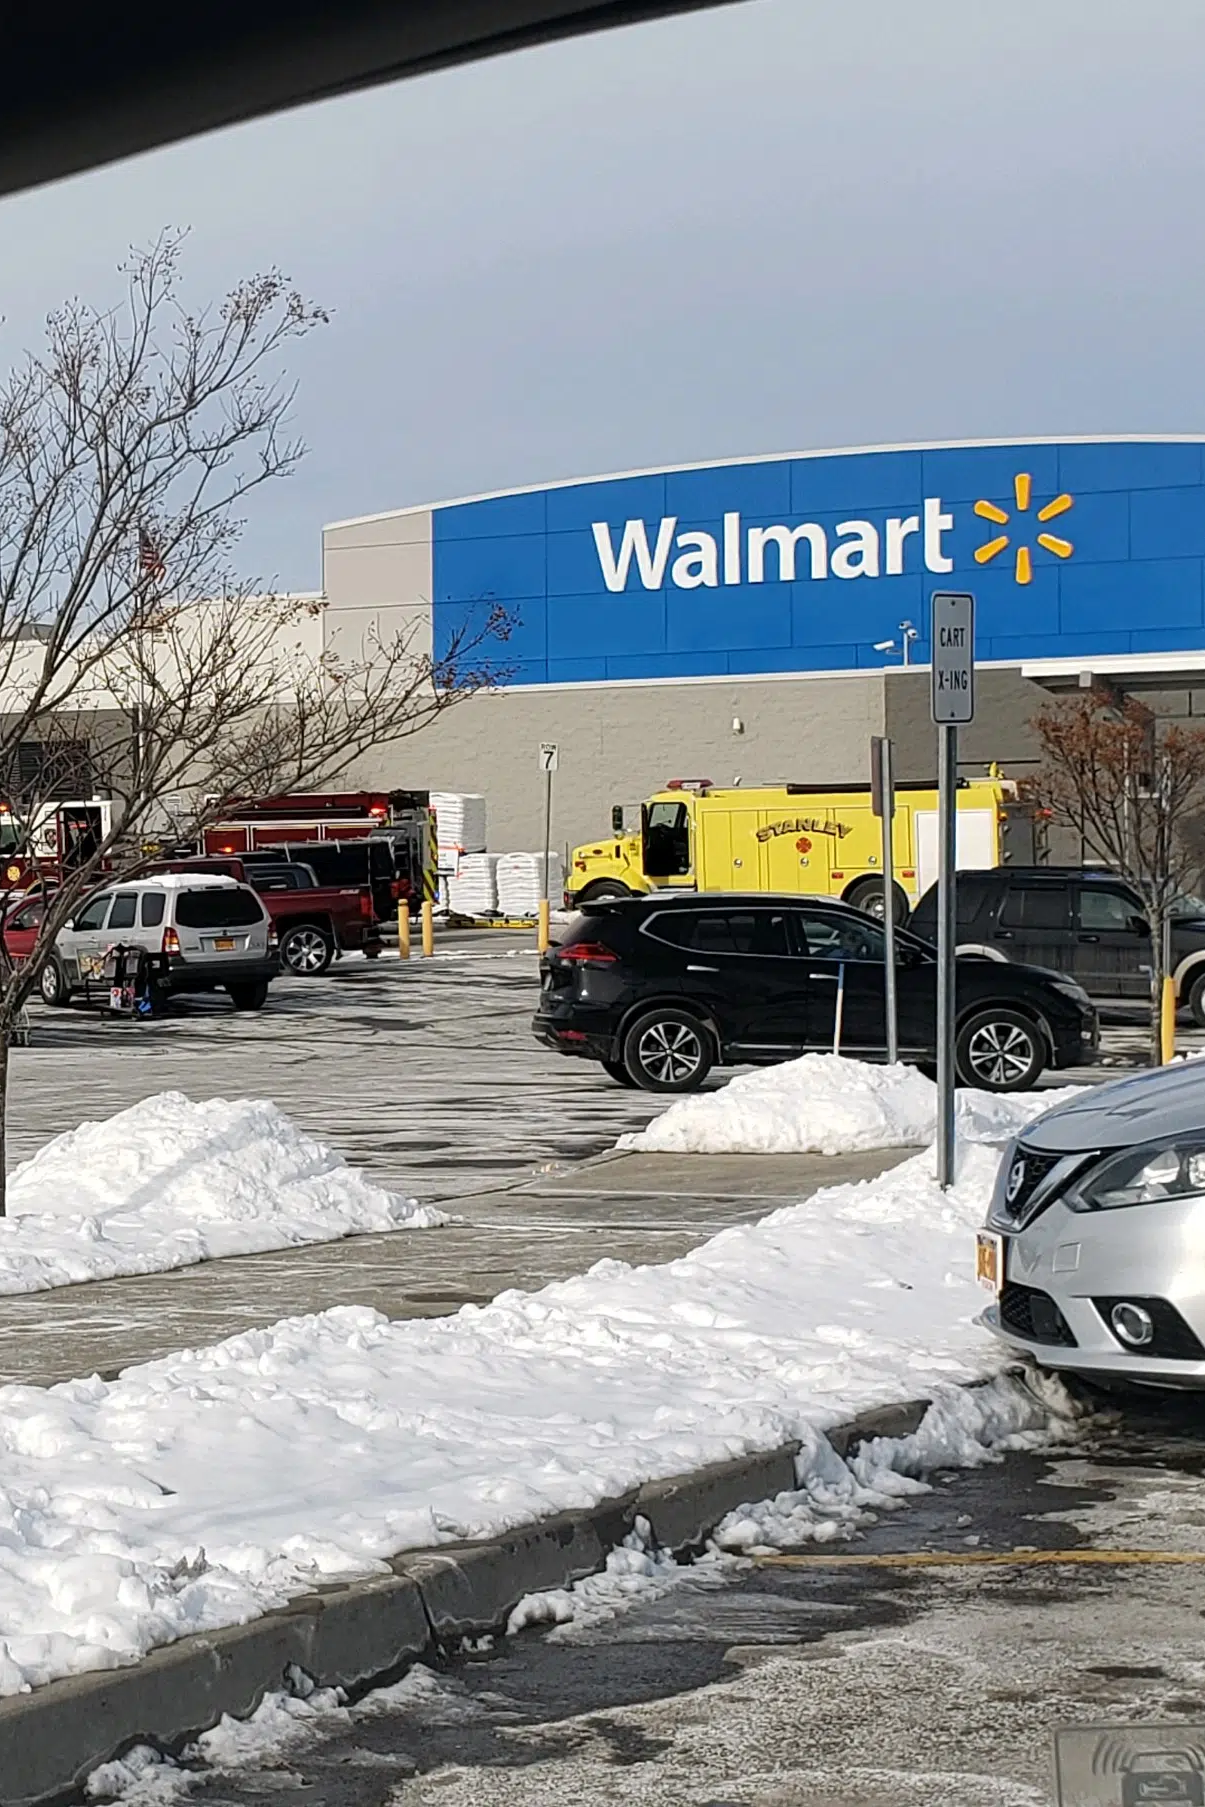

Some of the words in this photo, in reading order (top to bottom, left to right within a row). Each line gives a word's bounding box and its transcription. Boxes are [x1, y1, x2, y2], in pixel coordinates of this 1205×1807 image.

[591, 497, 954, 593] Walmart
[939, 627, 965, 648] CART
[938, 669, 968, 691] X-ING
[543, 751, 554, 769] 7
[756, 818, 853, 843] STANLEY
